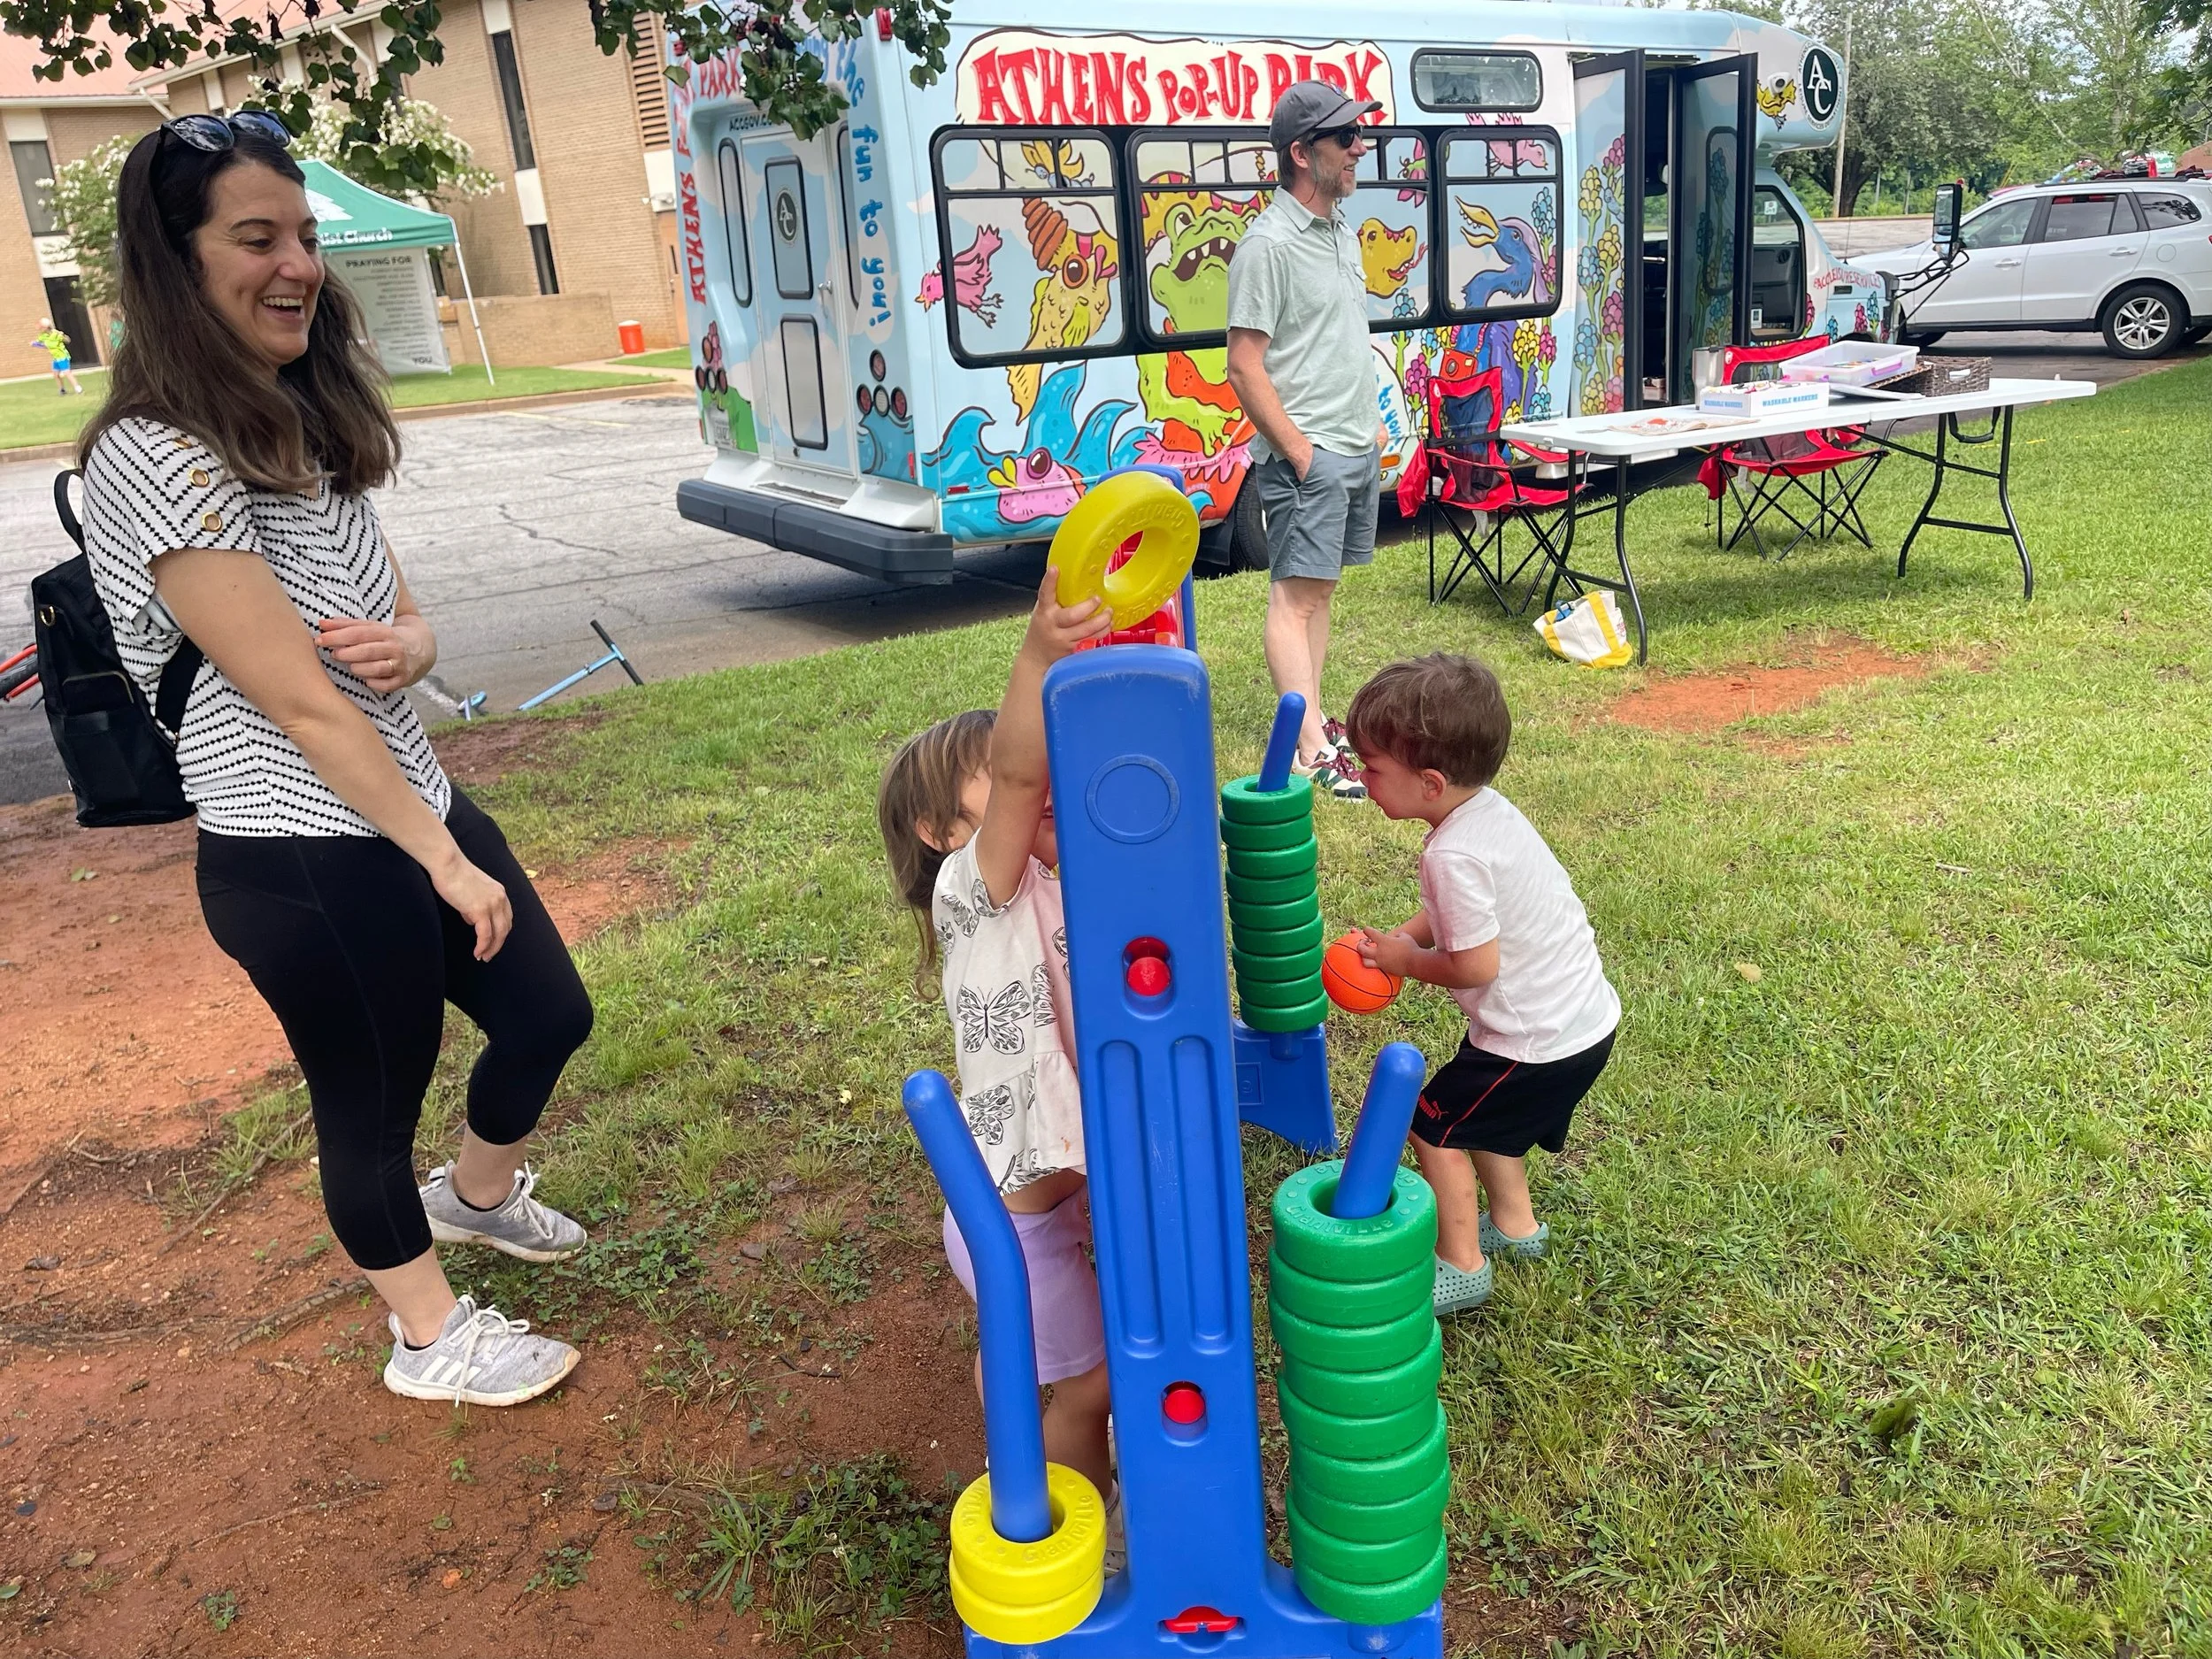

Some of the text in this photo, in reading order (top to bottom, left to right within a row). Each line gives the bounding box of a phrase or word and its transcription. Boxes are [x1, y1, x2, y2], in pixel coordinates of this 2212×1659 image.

[699, 46, 741, 100] PARK
[971, 47, 1151, 125] ATHENS
[835, 38, 892, 326] the fun to you!
[343, 227, 393, 244] Church
[680, 172, 707, 305] ATHENS
[346, 255, 412, 269] PRAYING FOR
[411, 355, 433, 365] YOU
[1763, 393, 1818, 407] WASHABLE MARKERS
[1383, 409, 1402, 453] you!
